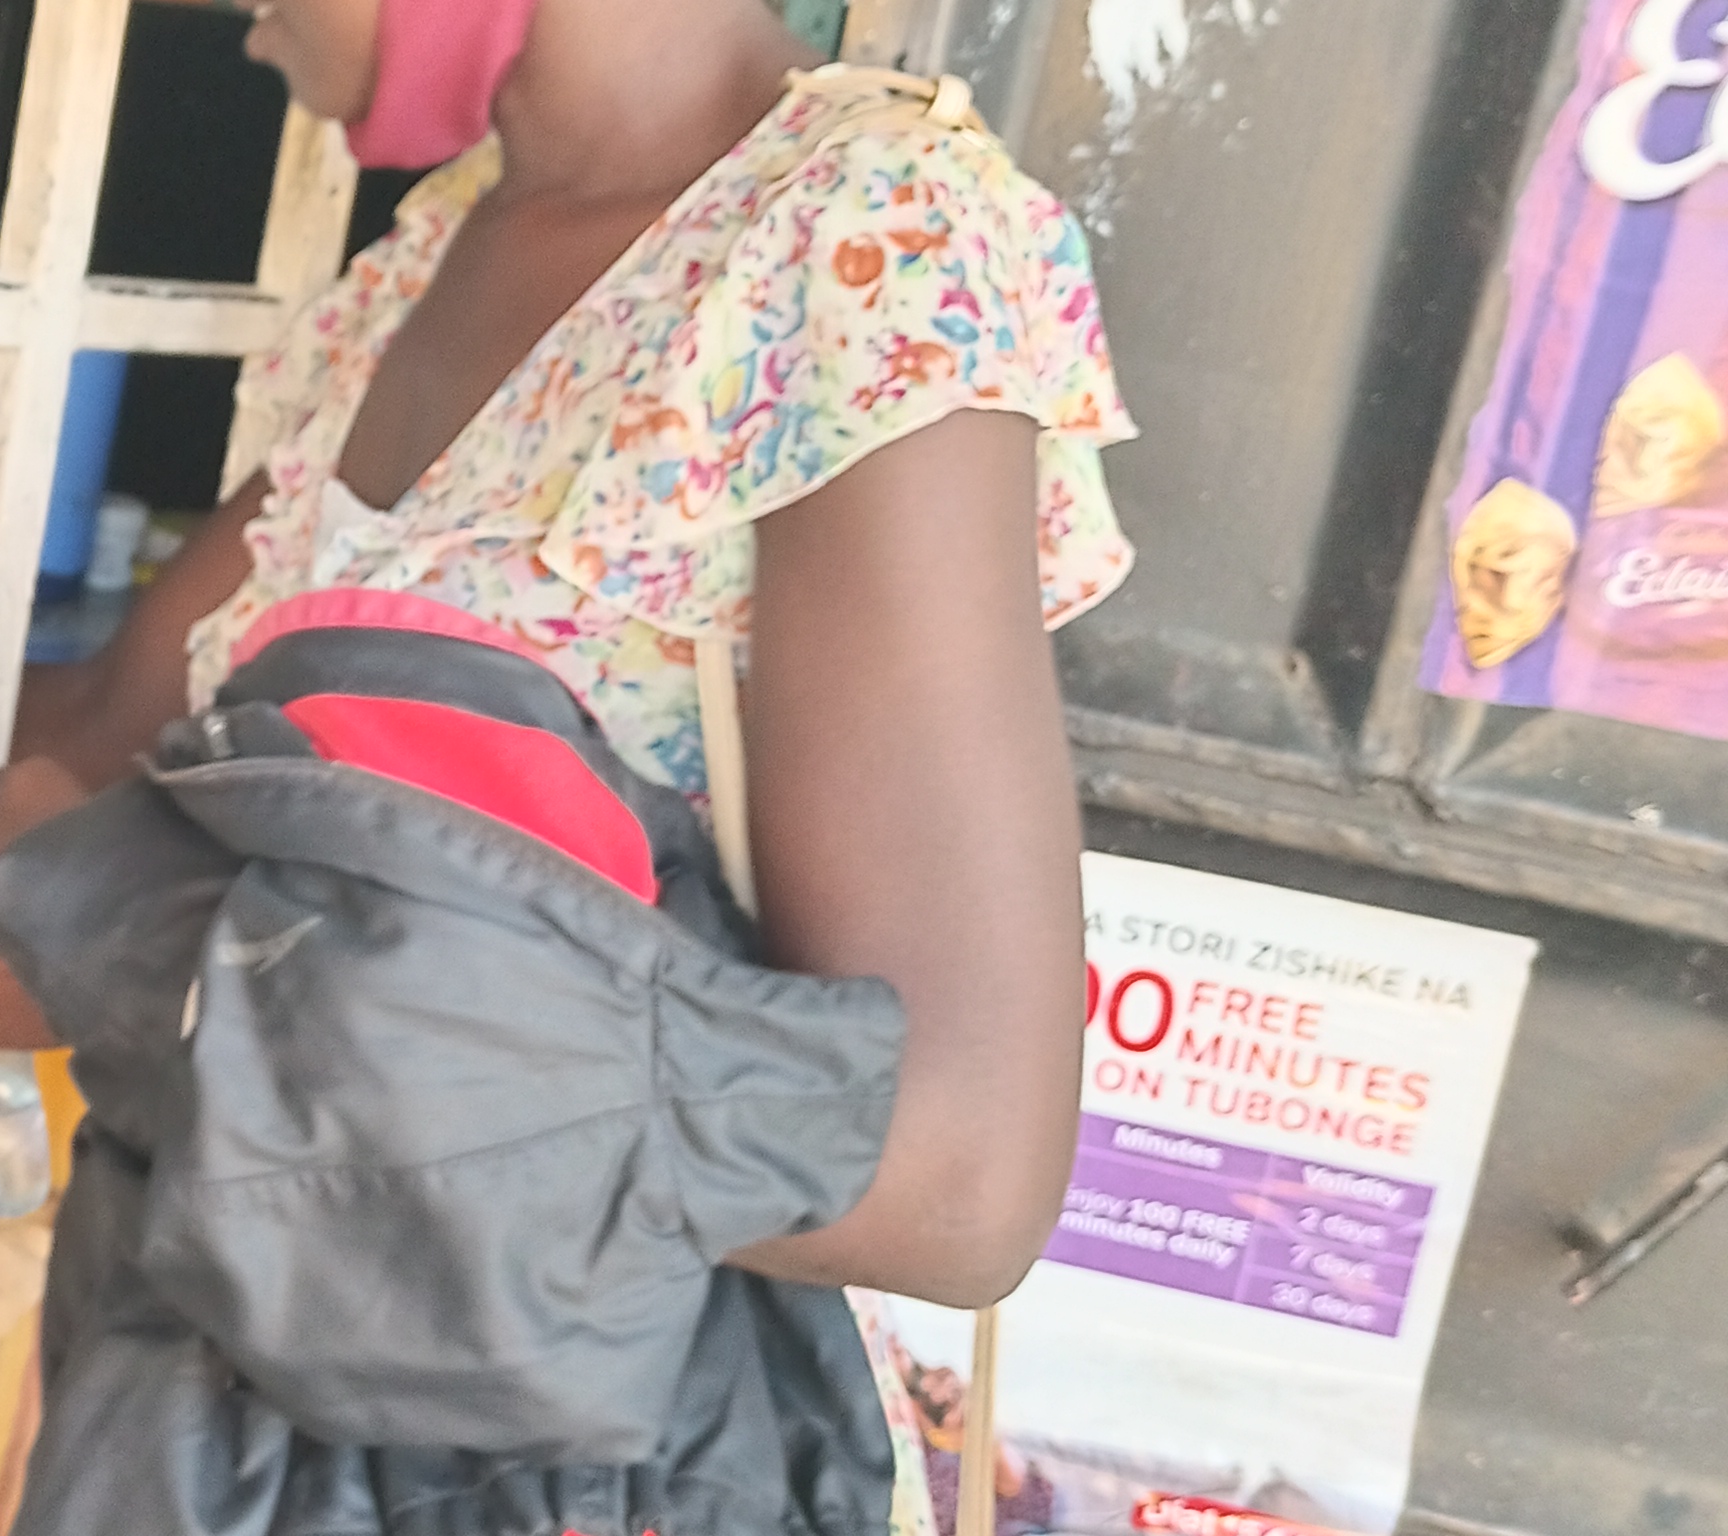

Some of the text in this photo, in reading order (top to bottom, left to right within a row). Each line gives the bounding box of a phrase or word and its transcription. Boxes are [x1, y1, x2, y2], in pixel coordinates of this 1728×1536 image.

[1119, 915, 1237, 962] STORI
[1245, 940, 1408, 999] ZISHIKE
[1413, 975, 1475, 1011] NA
[1186, 980, 1326, 1042] FREE
[1175, 1027, 1432, 1114] MINUTES
[1092, 1058, 1419, 1158] ON TUBONGE
[1113, 1124, 1225, 1170] Minutes
[1302, 1164, 1406, 1210] Validity
[1181, 1209, 1252, 1247] FREE
[1321, 1211, 1388, 1249] days
